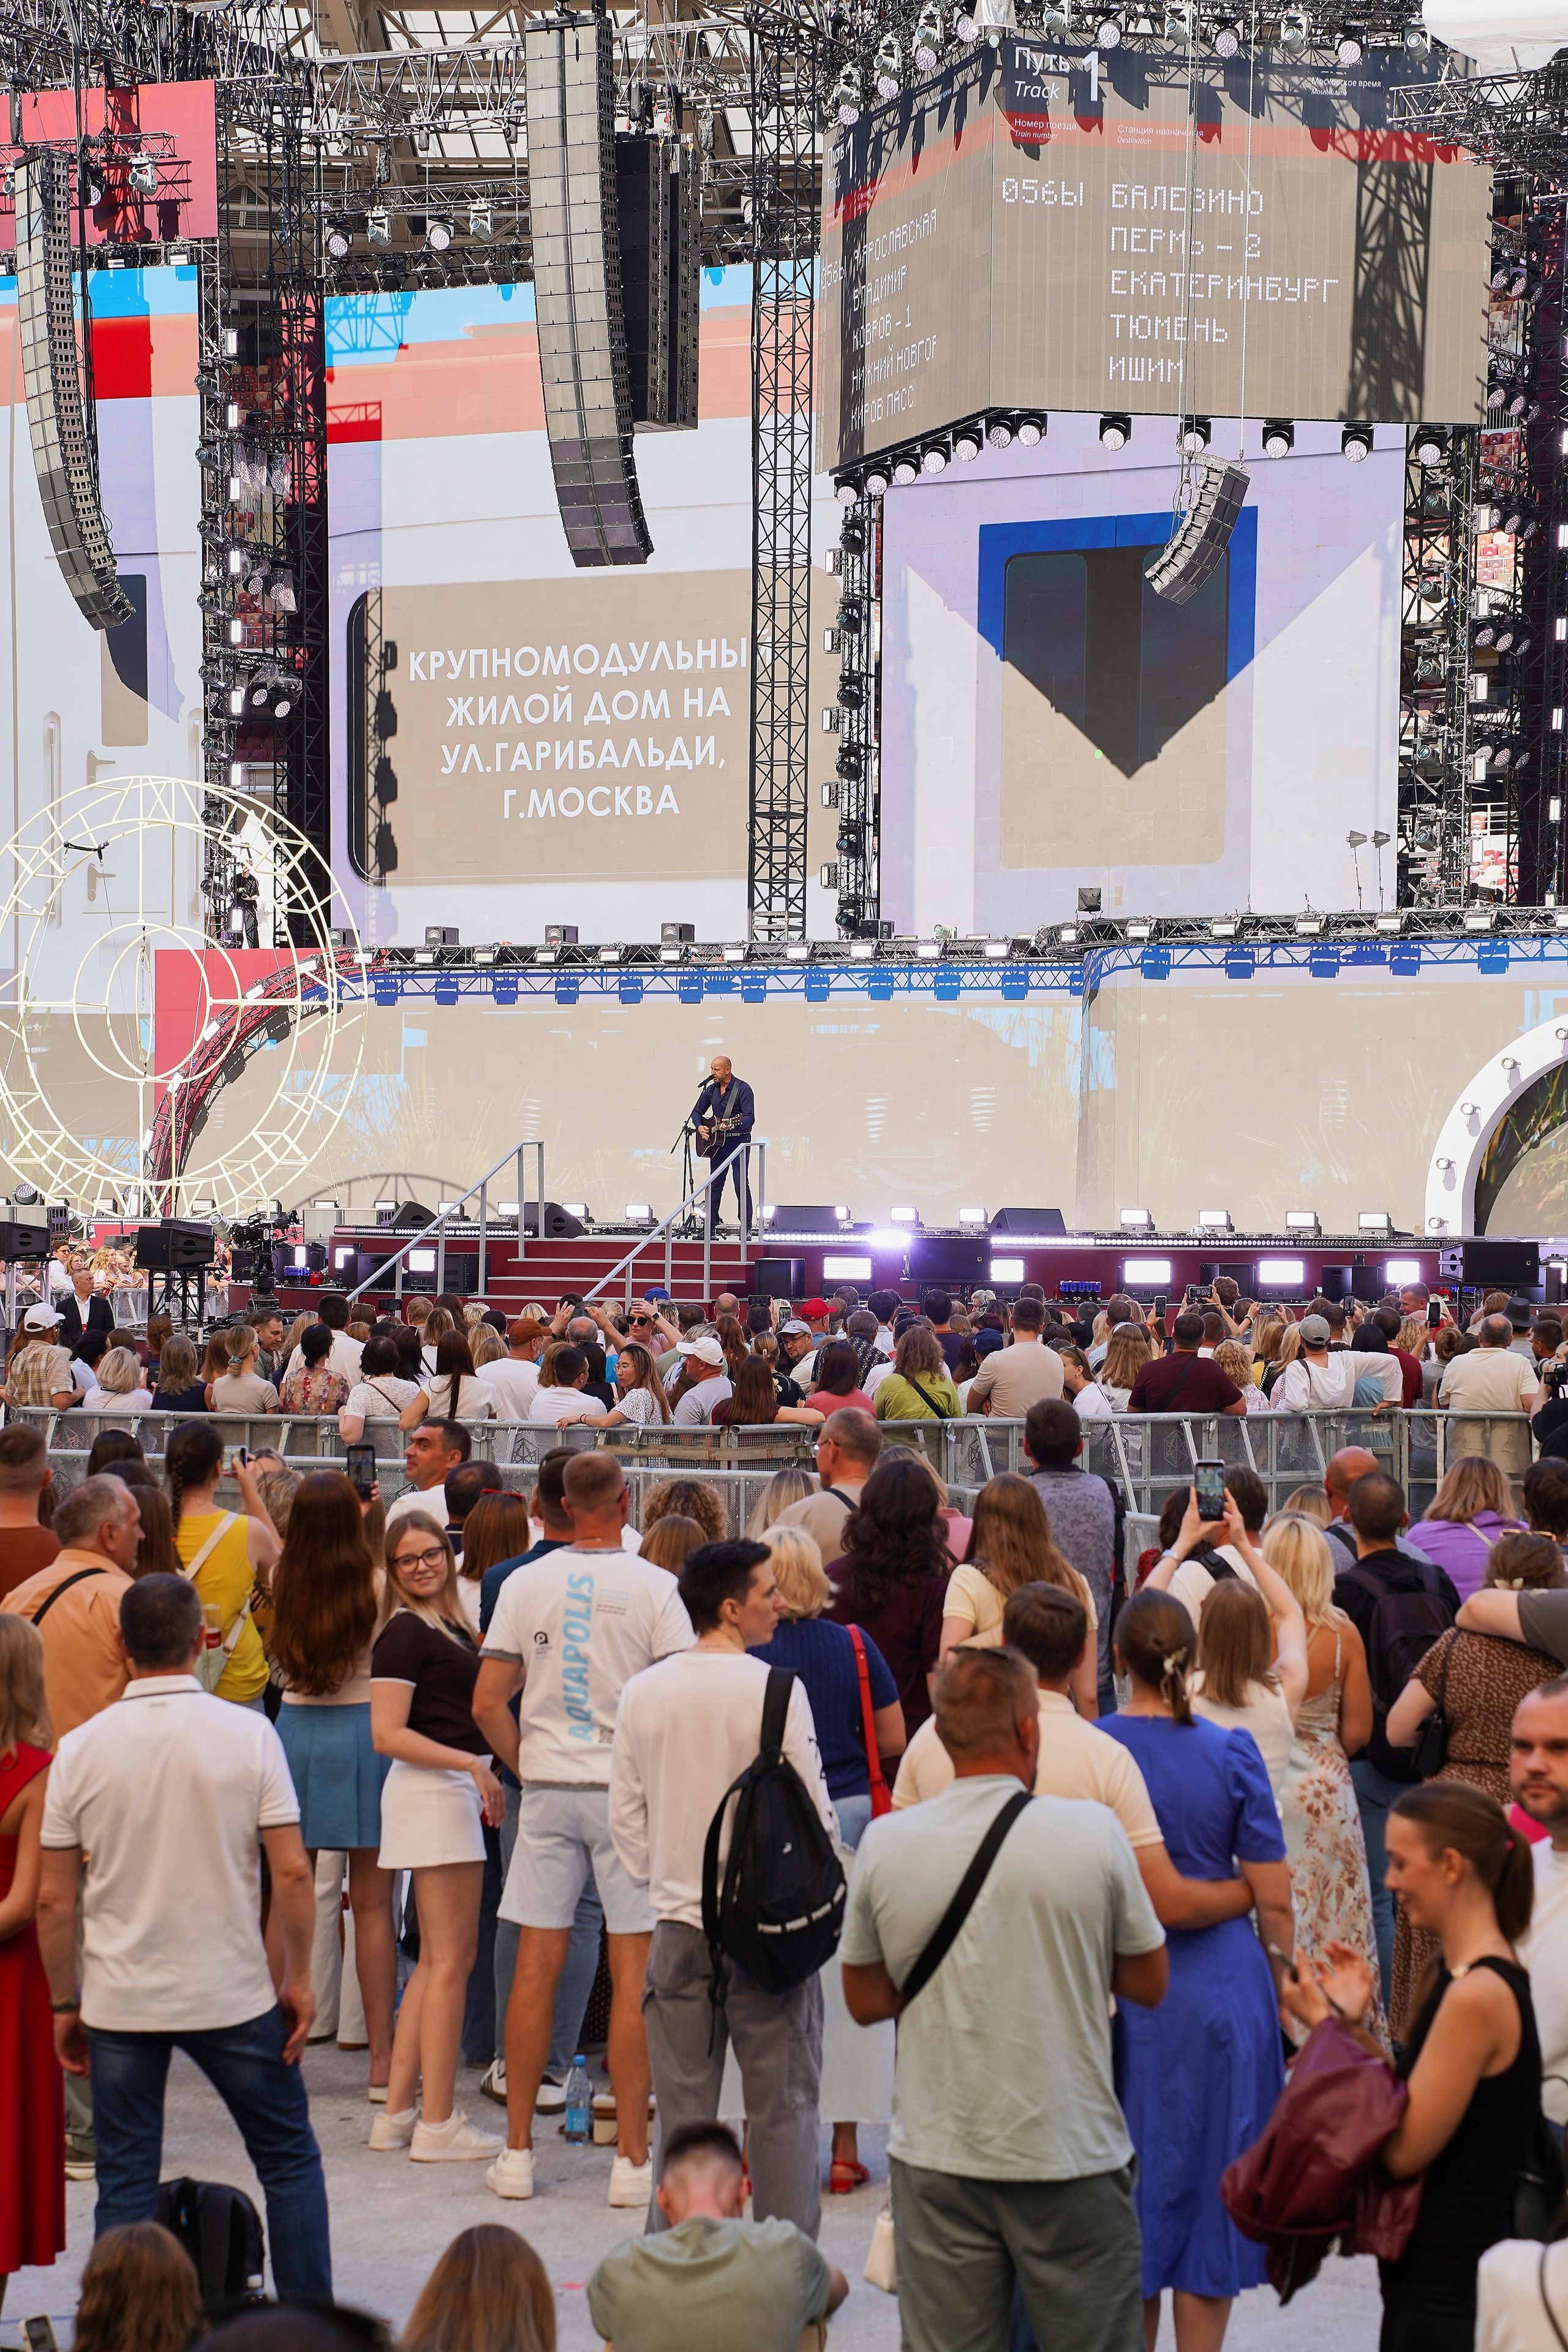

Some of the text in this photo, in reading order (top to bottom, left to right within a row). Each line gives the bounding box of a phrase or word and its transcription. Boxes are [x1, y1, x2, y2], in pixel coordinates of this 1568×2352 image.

[1014, 80, 1060, 99] Track
[1015, 46, 1099, 102] Путь 1
[1311, 77, 1382, 89] Московское время
[1014, 118, 1077, 131] Номер поезда
[1117, 124, 1154, 135] Станция
[1117, 136, 1152, 145] Destination
[847, 132, 854, 179] 1
[827, 171, 842, 194] Track
[1002, 178, 1264, 215] 056Ы БАЛЕЗИНО
[1111, 227, 1205, 255] ПЕРМЬ
[1245, 233, 1261, 258] 2
[853, 265, 908, 312] ВЛАДИМИР
[1110, 270, 1340, 303] ЕКАТЕРИНБУРГ
[853, 312, 892, 352] КОВРОВ
[905, 304, 911, 328] 1
[1110, 314, 1229, 343] ТЮМЕНЬ
[852, 344, 894, 393] НИЖНИЙ
[1109, 356, 1183, 383] ИШИМ
[851, 385, 914, 431] КИРОВ ПАСС
[445, 685, 733, 728] ЖИЛОЙ ДОМ НА
[440, 736, 727, 775] УЛ.ГАРИБАЛЬДИ,
[502, 784, 680, 820] Г.МОСКВА
[562, 1572, 594, 1743] AQUAPOLIS
